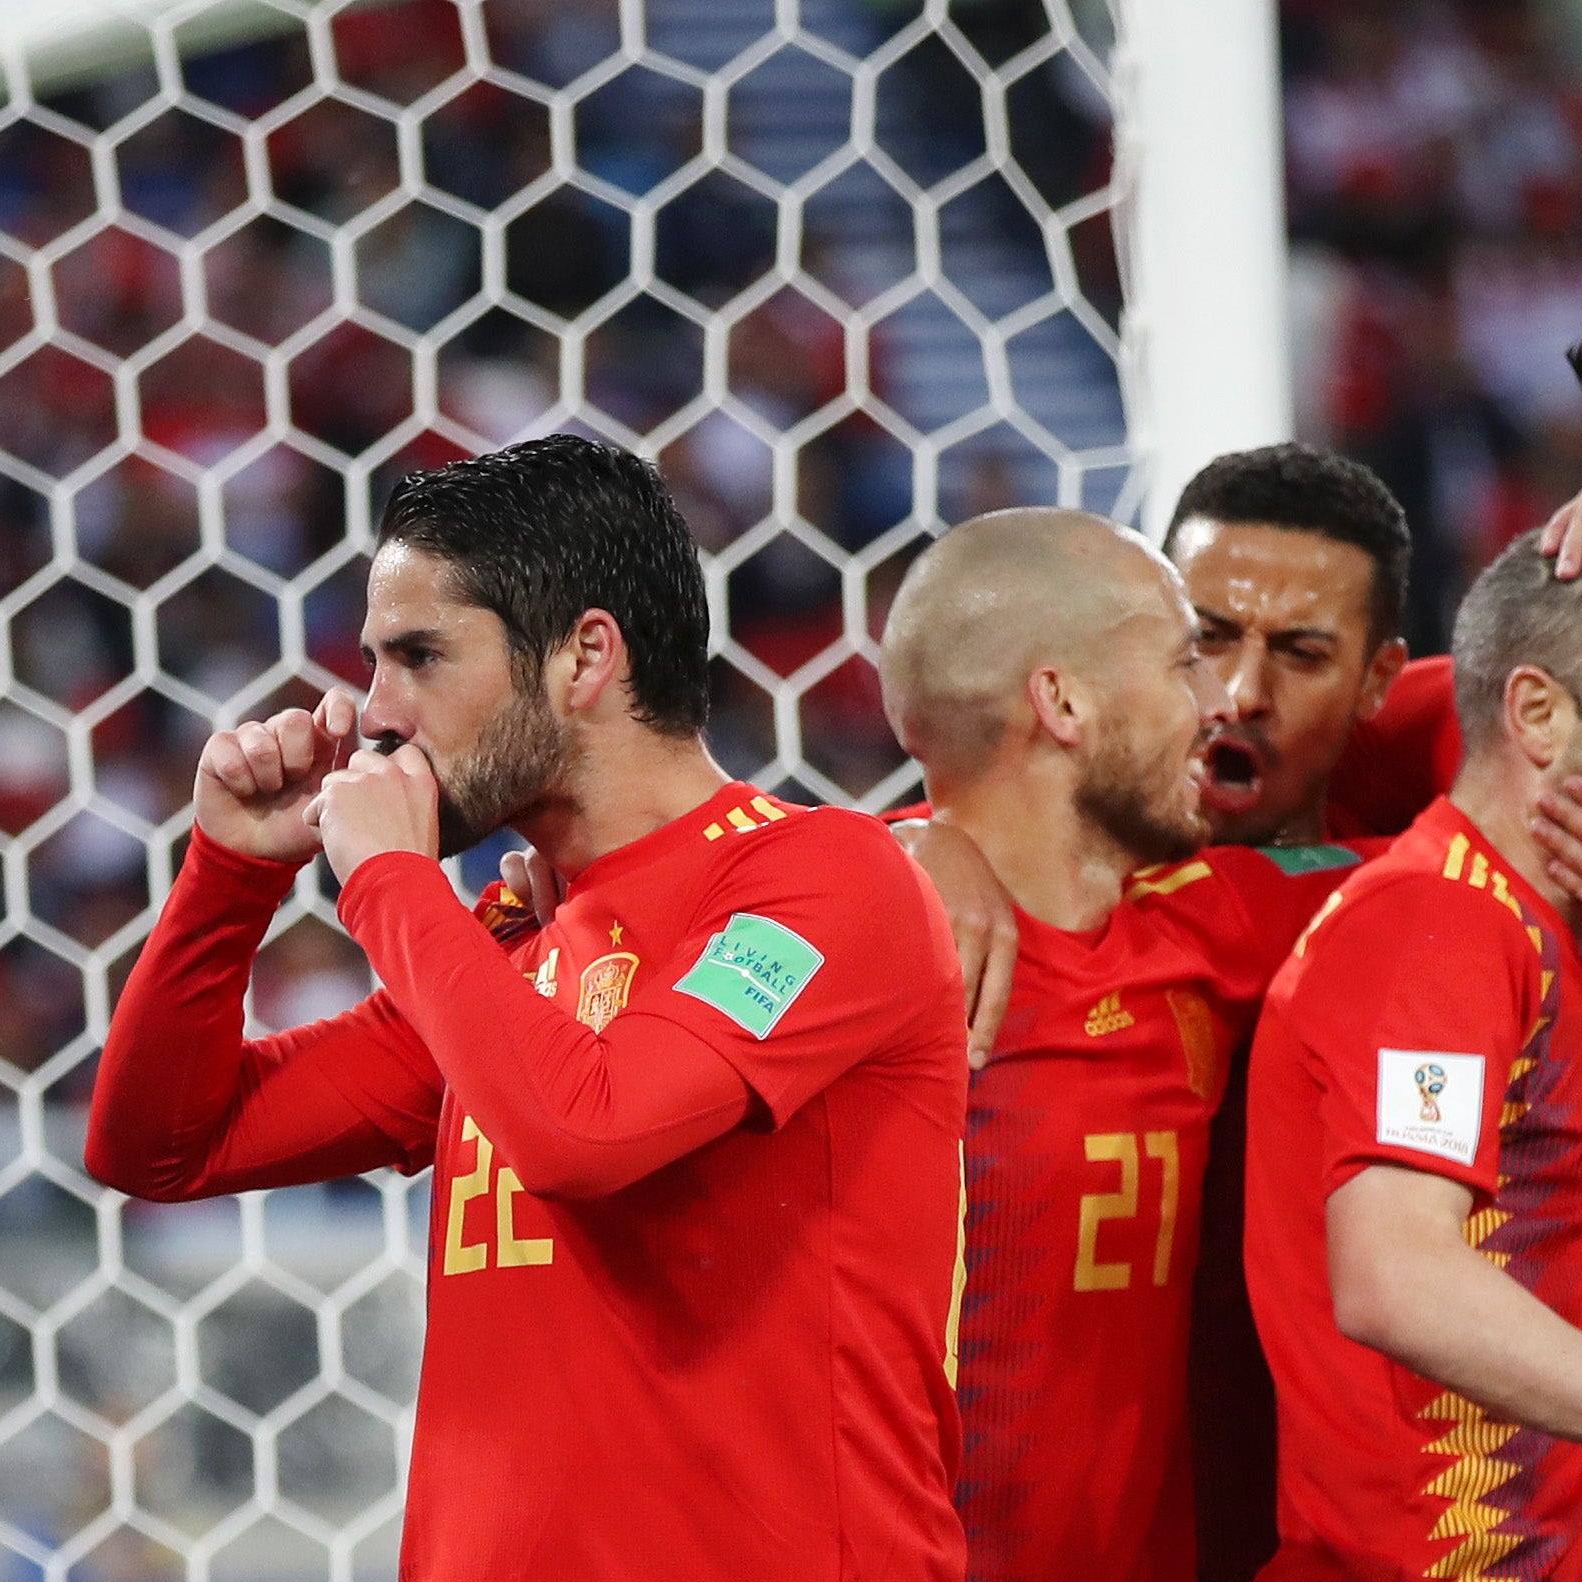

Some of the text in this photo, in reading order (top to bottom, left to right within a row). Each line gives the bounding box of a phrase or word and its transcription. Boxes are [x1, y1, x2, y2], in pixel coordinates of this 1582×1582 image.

[720, 935, 796, 986] LIVING
[744, 986, 775, 1013] FIFA
[1084, 1010, 1136, 1037] adidas
[1073, 1131, 1179, 1292] 21
